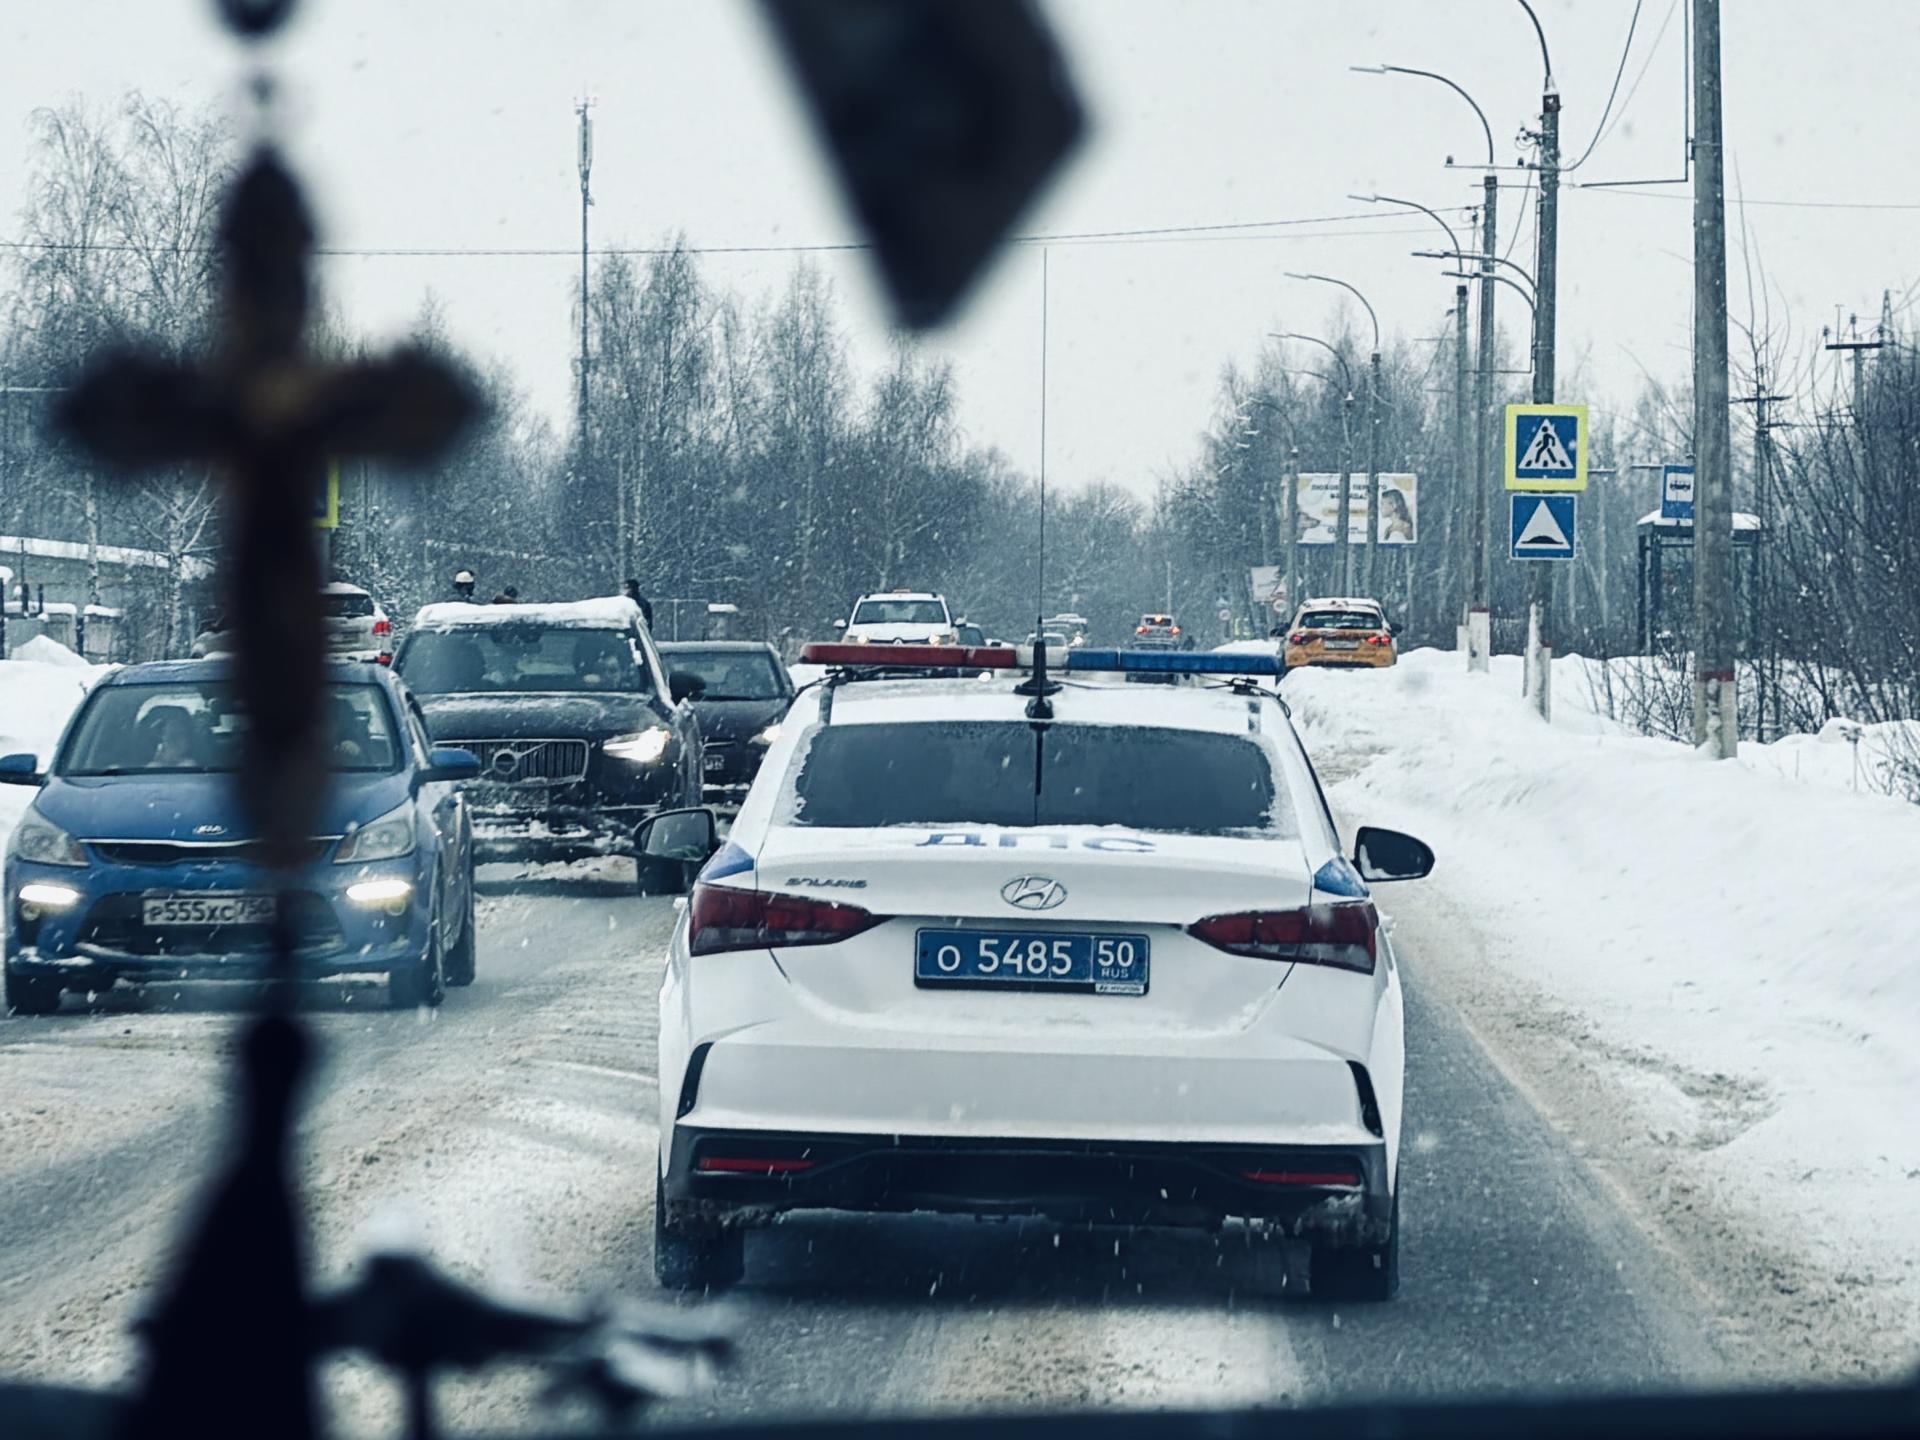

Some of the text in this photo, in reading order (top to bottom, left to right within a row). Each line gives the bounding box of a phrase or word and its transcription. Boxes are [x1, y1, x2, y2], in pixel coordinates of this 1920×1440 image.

[915, 832, 1157, 853] ДПС
[977, 938, 1073, 975] 5485
[1098, 940, 1135, 968] 50
[1100, 967, 1130, 979] RUS
